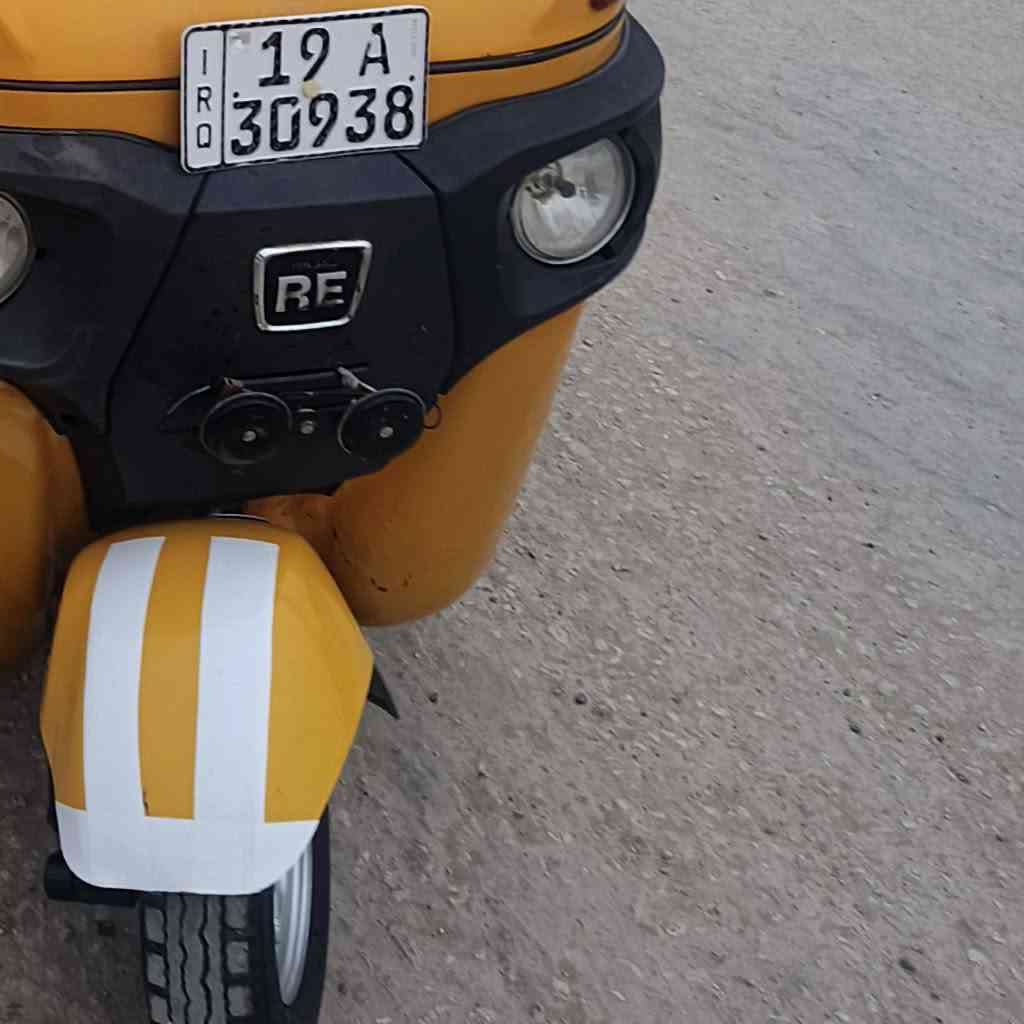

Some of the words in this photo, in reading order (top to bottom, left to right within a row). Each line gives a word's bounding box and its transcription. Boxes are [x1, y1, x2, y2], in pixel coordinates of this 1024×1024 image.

[259, 27, 330, 87] 19
[359, 22, 390, 76] A
[231, 84, 415, 156] 30938
[275, 270, 347, 313] RE
